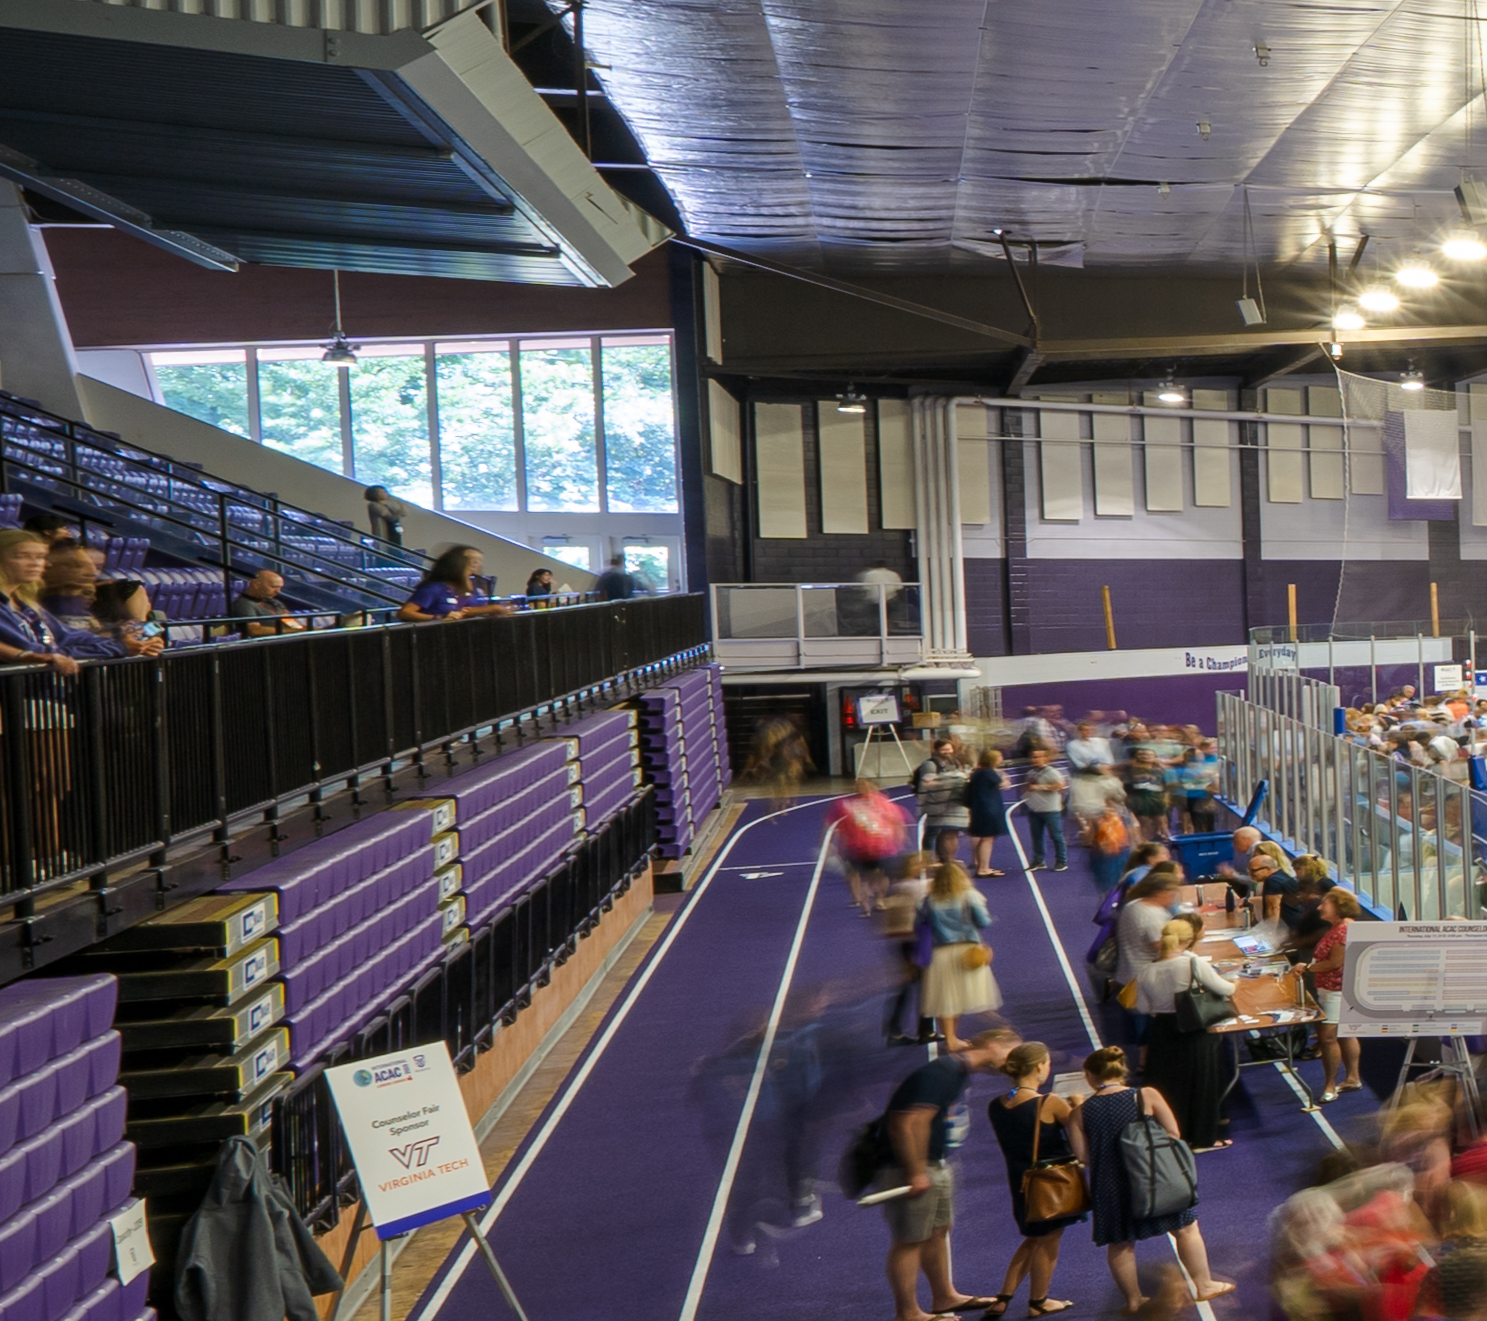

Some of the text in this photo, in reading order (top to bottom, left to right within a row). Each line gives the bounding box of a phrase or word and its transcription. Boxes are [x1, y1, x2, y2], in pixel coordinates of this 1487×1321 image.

[1185, 652, 1196, 667] Be
[1199, 658, 1203, 668] a
[1206, 656, 1247, 670] Champion
[374, 1067, 402, 1083] ACAC
[372, 1104, 440, 1128] Counselor Fair
[389, 1119, 429, 1136] Sponsor
[388, 1136, 440, 1170] VT
[378, 1158, 469, 1192] VIRGINIA TECH
